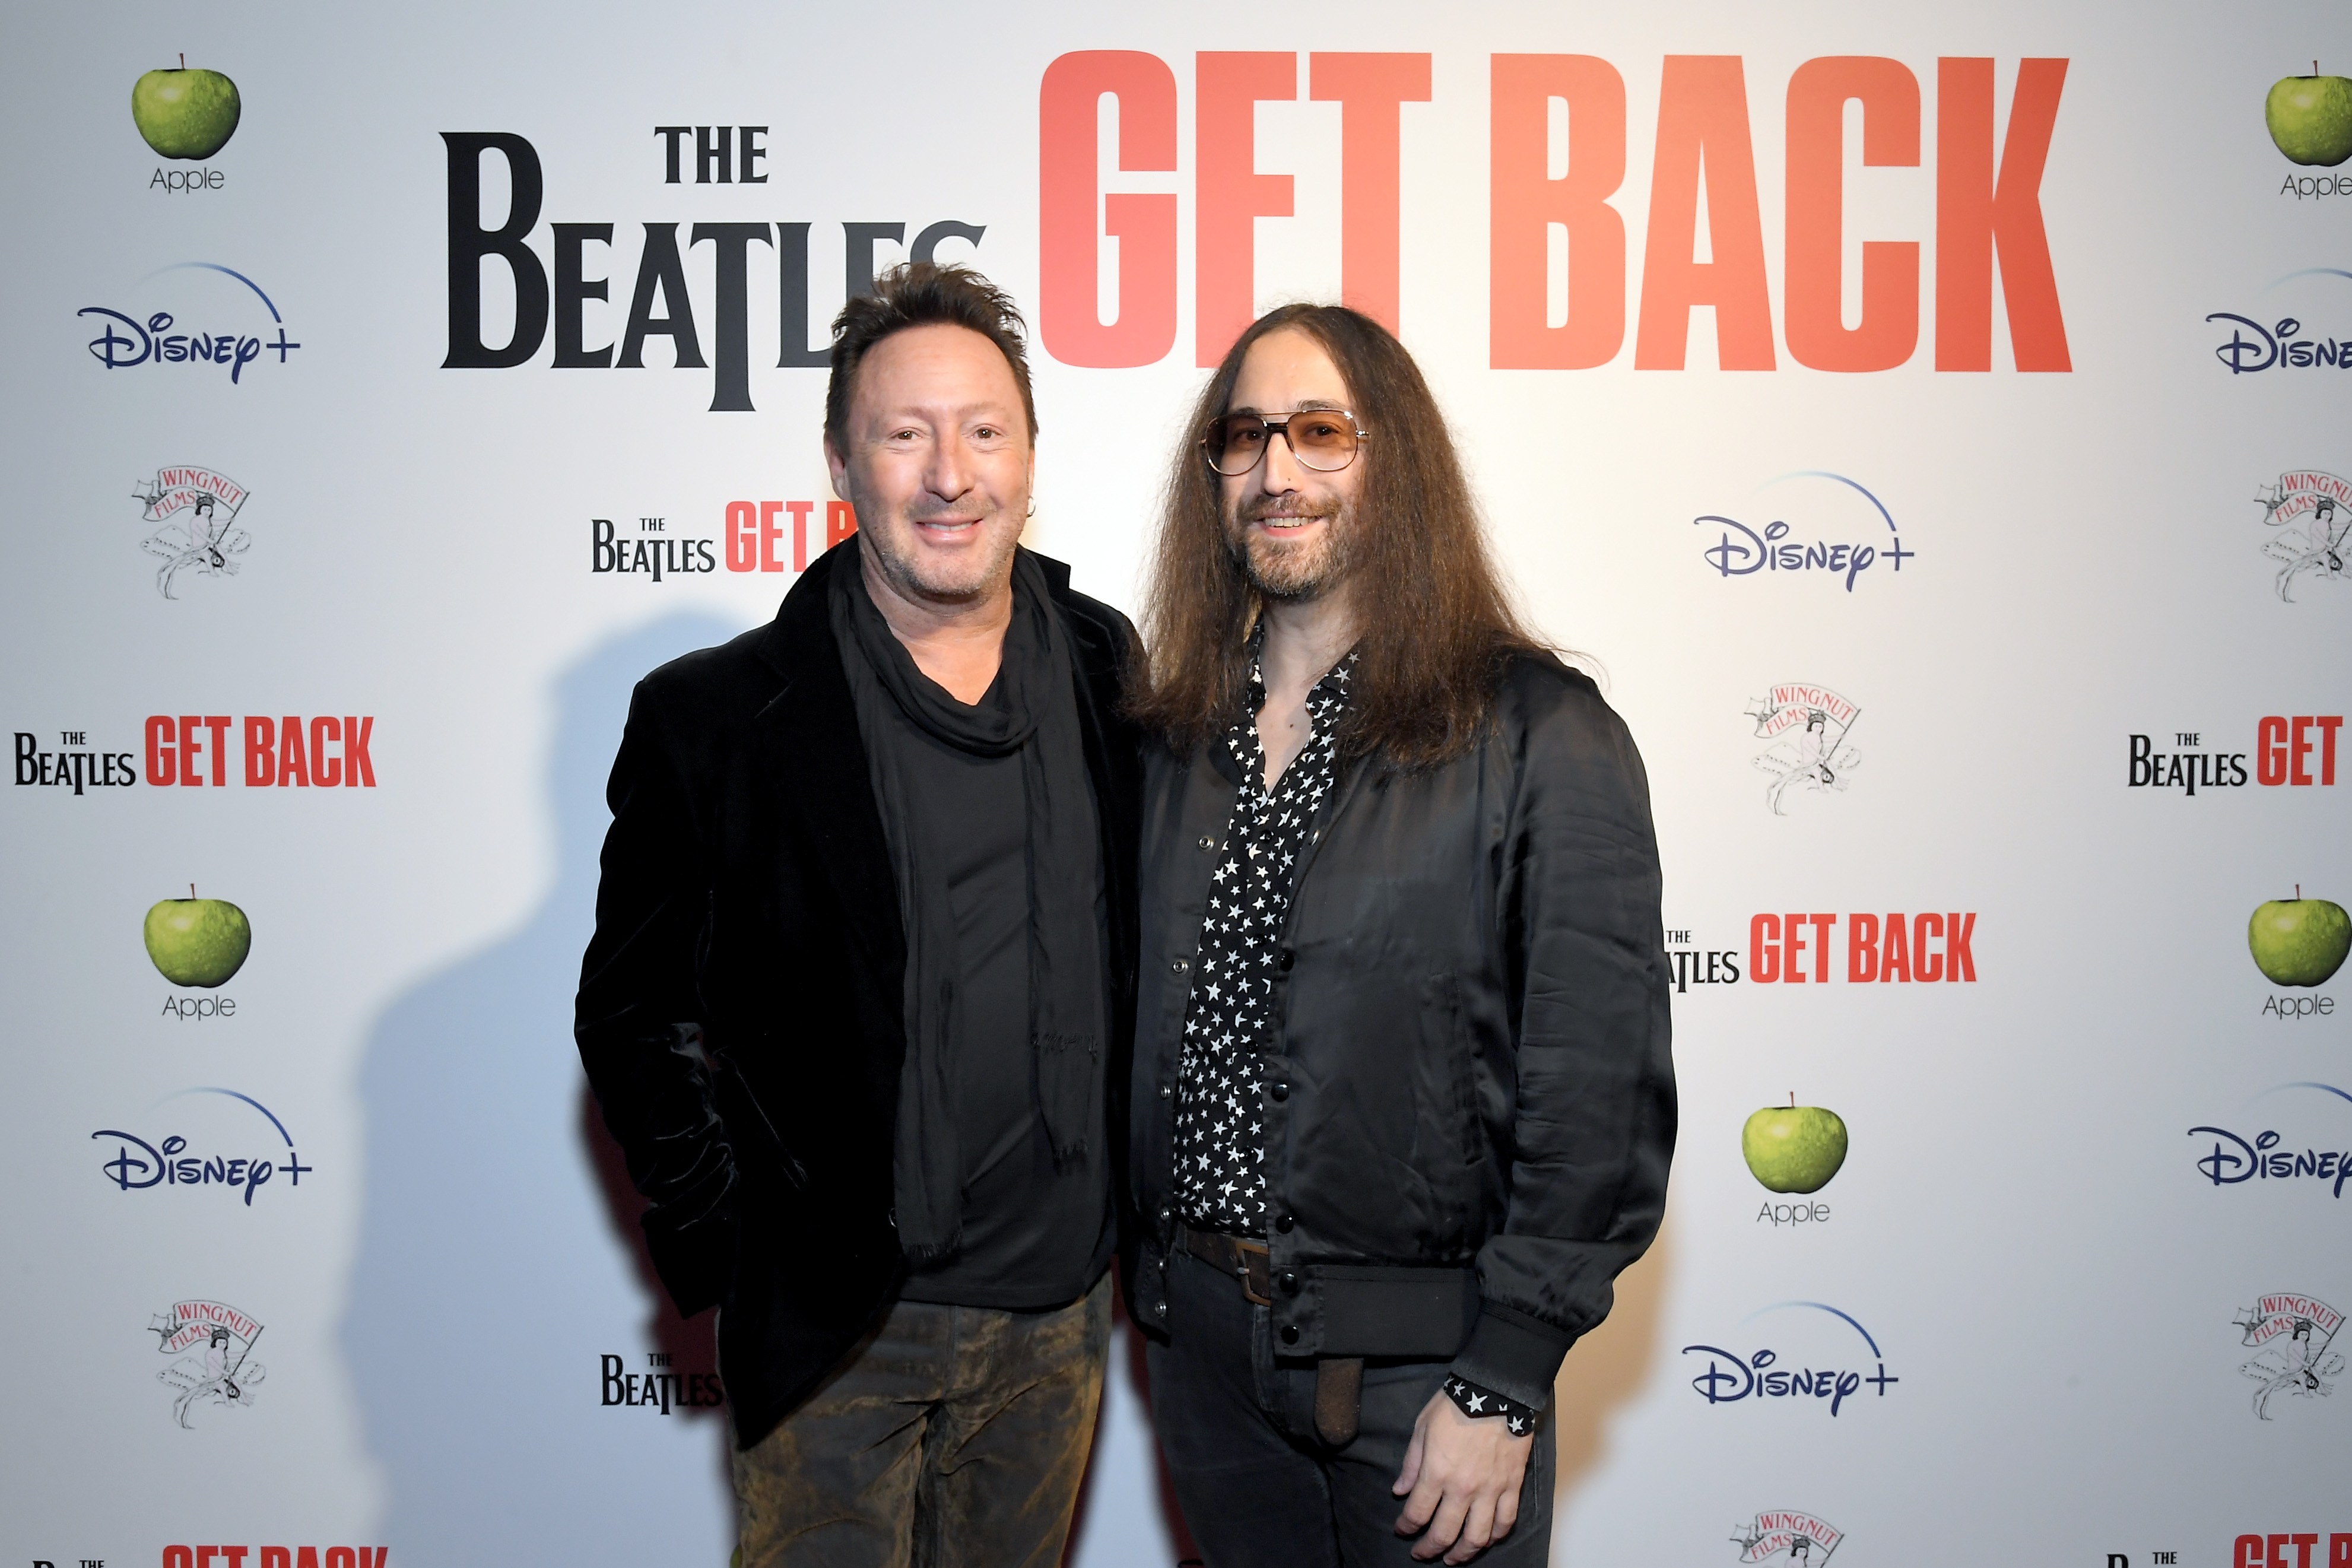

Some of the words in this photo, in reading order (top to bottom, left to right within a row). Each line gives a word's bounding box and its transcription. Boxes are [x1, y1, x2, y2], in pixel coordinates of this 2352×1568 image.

[654, 126, 769, 183] THE
[150, 167, 225, 194] Apple
[2281, 173, 2352, 200] Apple
[1040, 50, 1431, 369] GET
[1490, 53, 2072, 373] BACK
[162, 469, 243, 504] WINGNUT
[154, 491, 195, 518] FILMS
[2275, 495, 2317, 522] FILMS
[639, 518, 665, 531] THE
[591, 519, 716, 582] BEATLES
[725, 501, 814, 573] GET
[1774, 687, 1853, 722] WINGNUT
[1766, 707, 1808, 735] FILMS
[61, 732, 87, 745] THE
[2175, 733, 2201, 746] THE
[14, 732, 136, 796] BEATLES
[145, 716, 232, 787] GET
[245, 716, 377, 788] BACK
[2128, 735, 2248, 796] BEATLES
[2257, 716, 2343, 786] GET
[1666, 930, 1691, 943] THE
[1749, 913, 1837, 983] GET
[1848, 913, 1977, 983] BACK
[161, 995, 236, 1021] Apple
[2262, 994, 2335, 1020] Apple
[1757, 1201, 1830, 1227] Apple
[178, 1303, 256, 1338] WINGNUT
[2261, 1296, 2340, 1330] WINGNUT
[170, 1325, 210, 1350] FILMS
[2253, 1318, 2294, 1342] FILMS
[647, 1353, 672, 1366] THE
[601, 1354, 723, 1415] BEATLES
[1760, 1513, 1837, 1546] WINGNUT
[1751, 1534, 1792, 1560] FILMS
[2153, 1551, 2178, 1564] THE
